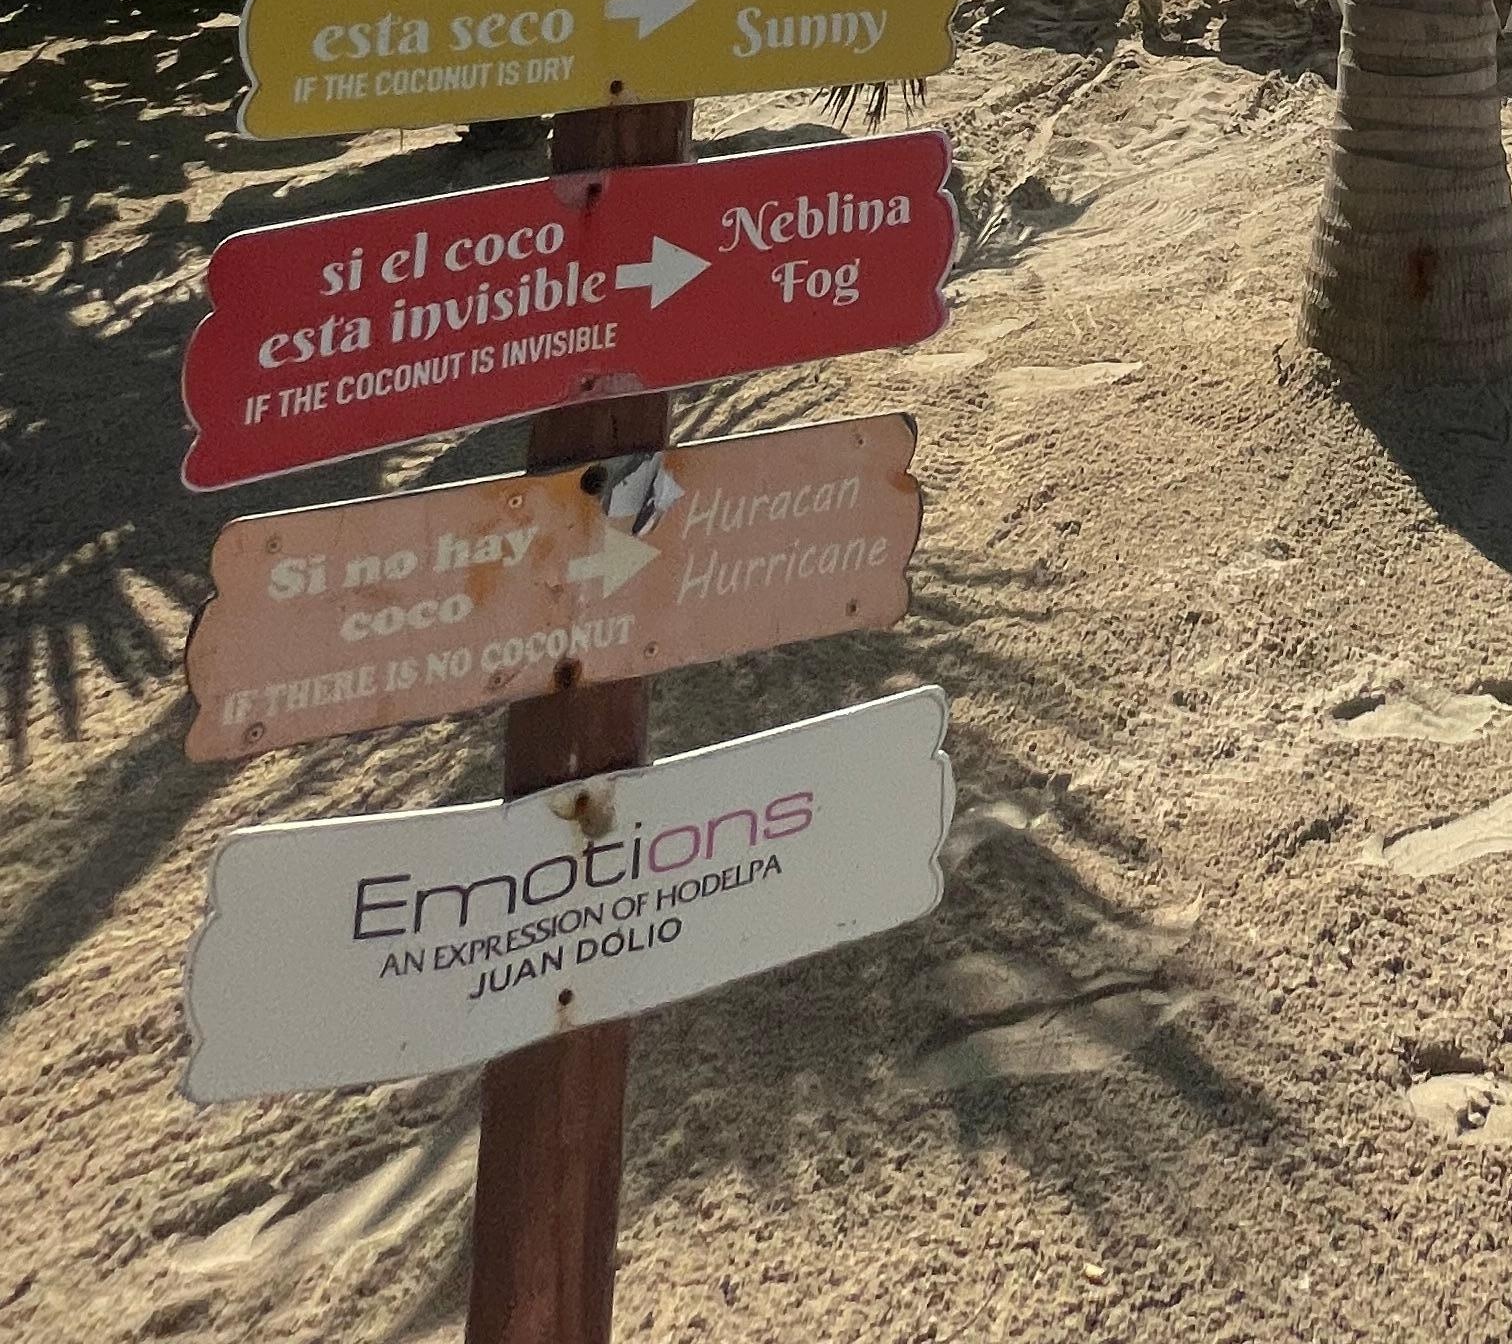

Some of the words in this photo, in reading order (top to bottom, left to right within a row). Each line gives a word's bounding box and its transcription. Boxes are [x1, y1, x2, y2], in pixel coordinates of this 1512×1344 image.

[311, 12, 431, 63] esta
[449, 7, 575, 53] seco
[731, 3, 888, 58] Sunny
[293, 77, 318, 104] IF
[322, 73, 369, 101] THE
[376, 63, 493, 97] COCONUT
[498, 61, 520, 86] IS
[527, 55, 575, 84] DRY
[718, 190, 911, 253] Neblina
[320, 247, 363, 296] si
[380, 232, 428, 283] el
[444, 220, 566, 273] coco
[771, 257, 860, 306] Fog
[258, 313, 372, 370] esta
[391, 266, 607, 345] invisible
[245, 395, 272, 425] IF
[278, 386, 330, 418] THE
[337, 353, 465, 406] COCONUT
[469, 346, 496, 377] IS
[501, 322, 617, 369] INVISIBLE
[681, 474, 860, 541] Huracan
[268, 554, 326, 603] Si
[344, 551, 416, 590] no
[431, 523, 541, 573] hay
[676, 531, 889, 607] Hurricane
[339, 593, 476, 643] coco
[223, 690, 258, 726] IF
[264, 665, 377, 718] THERE
[384, 657, 419, 692] IS
[424, 647, 473, 685] NO
[480, 613, 637, 673] COCONUT
[353, 790, 814, 941] Emotions
[380, 947, 426, 979] AN
[432, 904, 605, 972] EXPRESSION
[611, 893, 652, 924] OF
[656, 854, 784, 913] HODELPA
[468, 946, 564, 1001] JUAN
